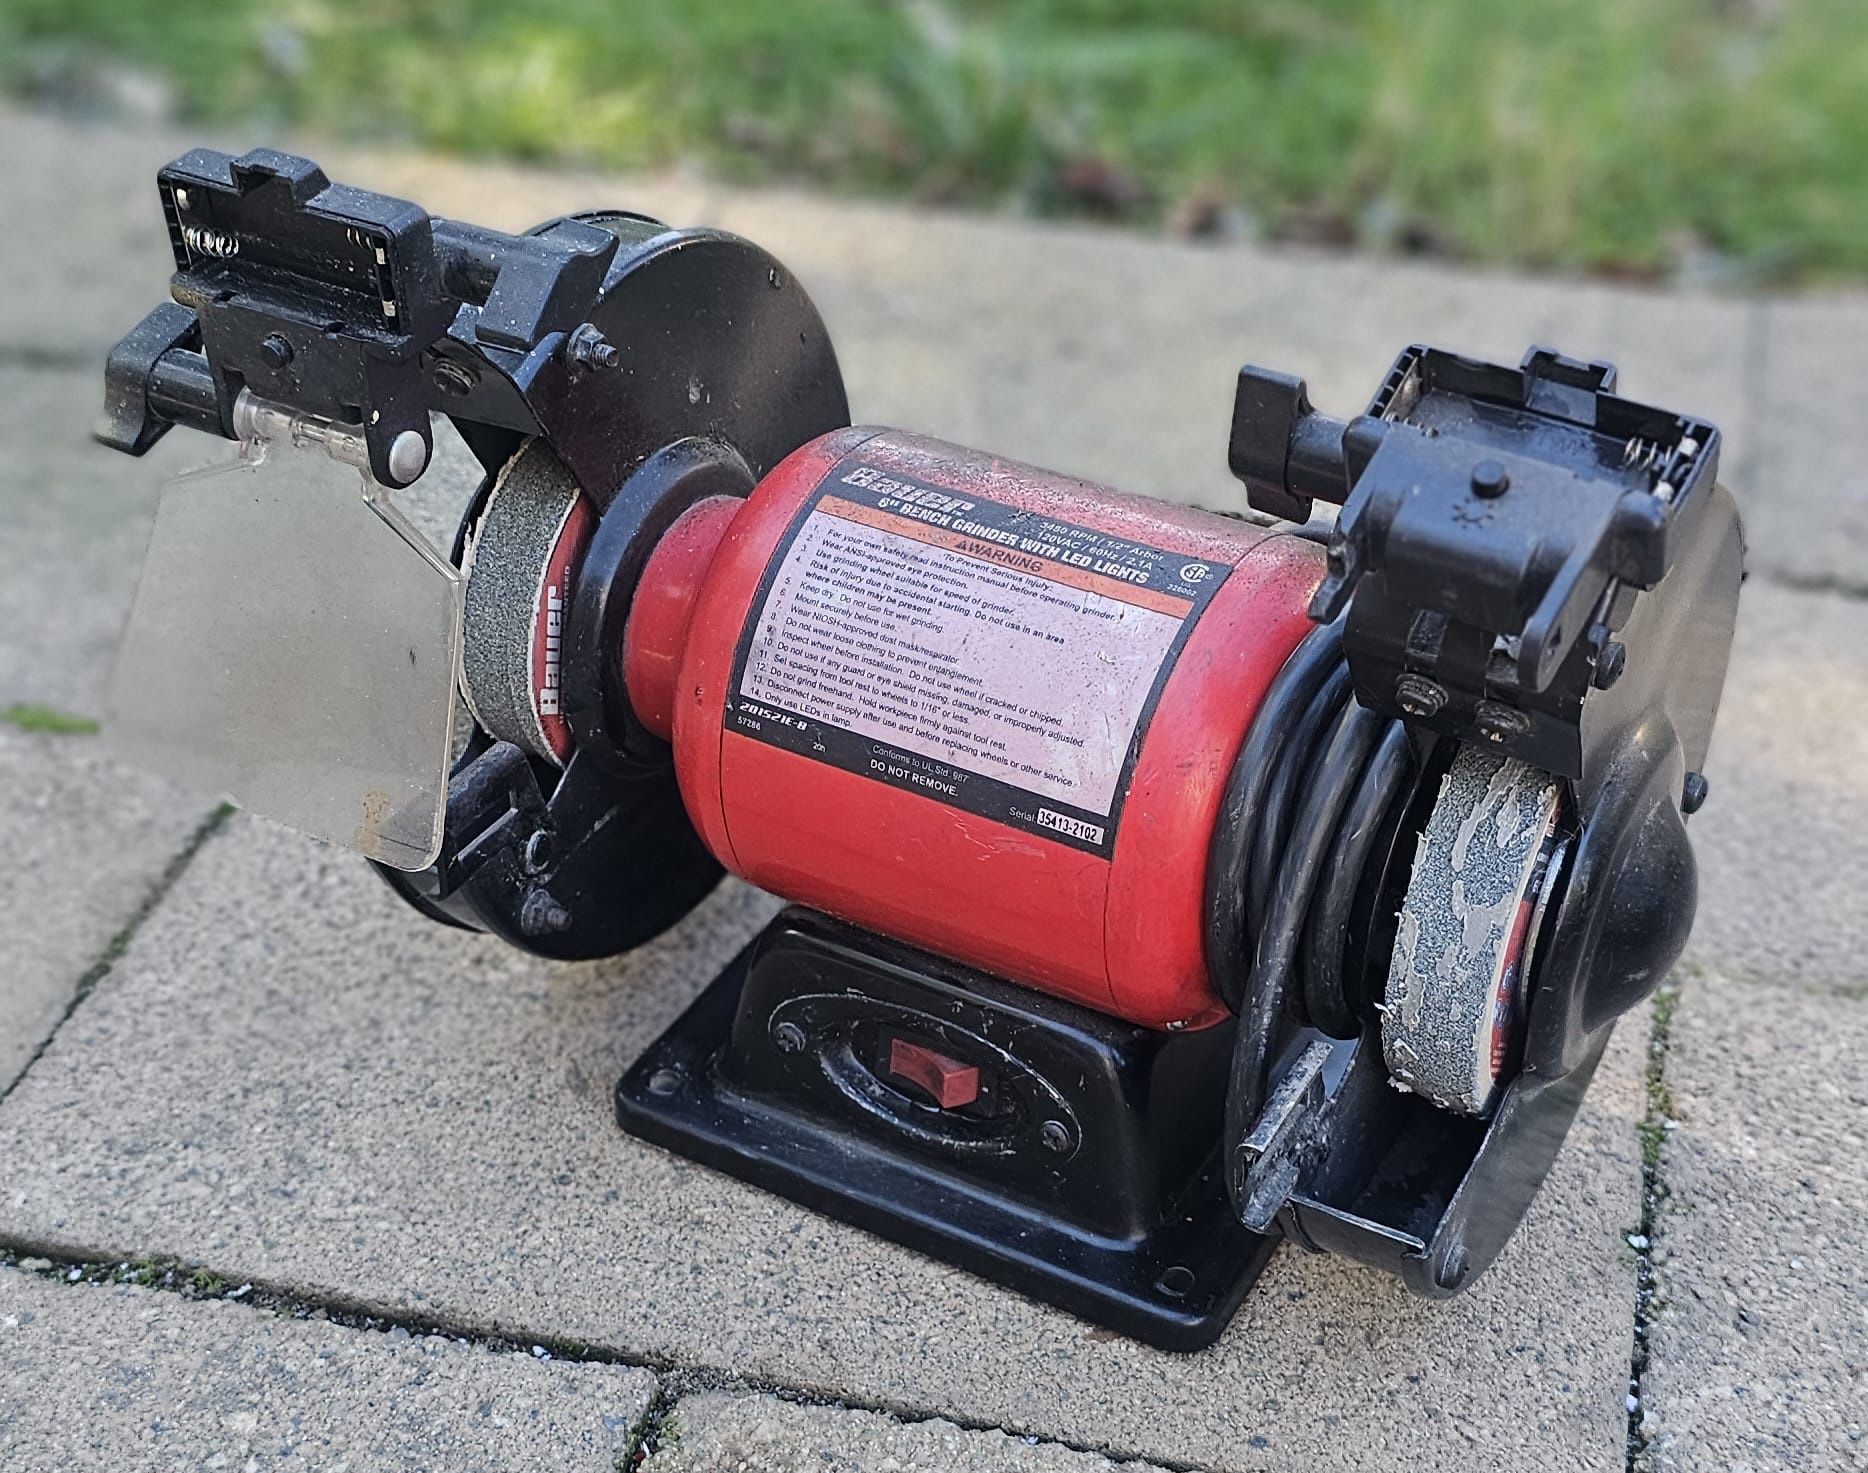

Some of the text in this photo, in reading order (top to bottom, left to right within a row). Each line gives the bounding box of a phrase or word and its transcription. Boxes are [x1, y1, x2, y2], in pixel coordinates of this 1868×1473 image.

[841, 467, 975, 512] Bauer
[822, 539, 968, 589] Wear ANSI-approved eye protection.
[878, 497, 1150, 583] 6" BENCH GRINDER WITH LED LIGHTS
[964, 542, 1044, 572] WARNING
[1038, 529, 1152, 570] 120VAC 60Hz 2.1A
[1069, 530, 1098, 542] RPM
[1129, 548, 1164, 561] Arbor
[806, 571, 896, 604] where children may be
[816, 549, 832, 560] Use
[833, 556, 868, 572] grinding
[870, 567, 895, 579] wheel
[895, 575, 928, 590] suitable
[930, 584, 943, 593] for
[944, 590, 971, 603] speed
[981, 601, 1016, 616] grinder.
[827, 529, 842, 539] For
[842, 535, 863, 544] your
[864, 541, 882, 551] own
[883, 544, 908, 560] safety
[909, 555, 929, 565] read
[977, 575, 1010, 589] manual
[1009, 584, 1038, 597] before
[1039, 594, 1081, 612] operating
[945, 554, 955, 562] To
[956, 557, 989, 572] Prevent
[990, 568, 1023, 582] Serious
[791, 604, 811, 618] Wear
[880, 634, 897, 645] dust
[794, 592, 897, 632] Mount securely before use.
[799, 581, 944, 634] Keep Do not use for wet grinding.
[810, 560, 828, 571] Risk
[866, 578, 881, 588] due
[883, 583, 892, 591] to
[893, 587, 937, 605] accidental
[974, 610, 987, 620] Do
[988, 616, 1004, 626] not
[1005, 622, 1020, 631] use
[1022, 625, 1030, 634] in
[1032, 630, 1043, 639] an
[1045, 633, 1064, 645] area
[540, 585, 563, 715] Bauer
[781, 628, 809, 645] Inspect
[811, 640, 834, 652] wheel
[835, 646, 860, 661] before
[909, 670, 921, 681] Do
[921, 676, 936, 686] not
[937, 680, 952, 690] use
[954, 686, 978, 699] wheel
[978, 693, 985, 701] if
[985, 696, 1018, 712] cracked
[1019, 707, 1028, 715] or
[786, 617, 983, 688] Do not wear loose clothing to prevent entanglement.
[765, 691, 852, 728] Only use LEDs in lamp.
[770, 666, 1006, 751] Do not grind freehand. Hold workpiece firmly against tool rest.
[774, 654, 951, 718] Set spacing from tool rest to wheels to or
[777, 641, 789, 652] Do
[790, 647, 803, 656] not
[804, 652, 818, 661] use
[826, 659, 841, 670] any
[842, 665, 866, 676] guard
[866, 672, 876, 680] or
[877, 675, 891, 685] eye
[893, 680, 916, 693] shield
[993, 713, 1002, 721] or
[1004, 715, 1047, 737] improperly
[767, 678, 1042, 776] Disconnect power supply after use and before replacing wheels or other
[870, 759, 958, 796] DO NOT REMOVE.
[873, 744, 910, 764] Conforms
[912, 758, 920, 767] to
[922, 761, 934, 773] UL
[1038, 811, 1097, 841] 35413-2102
